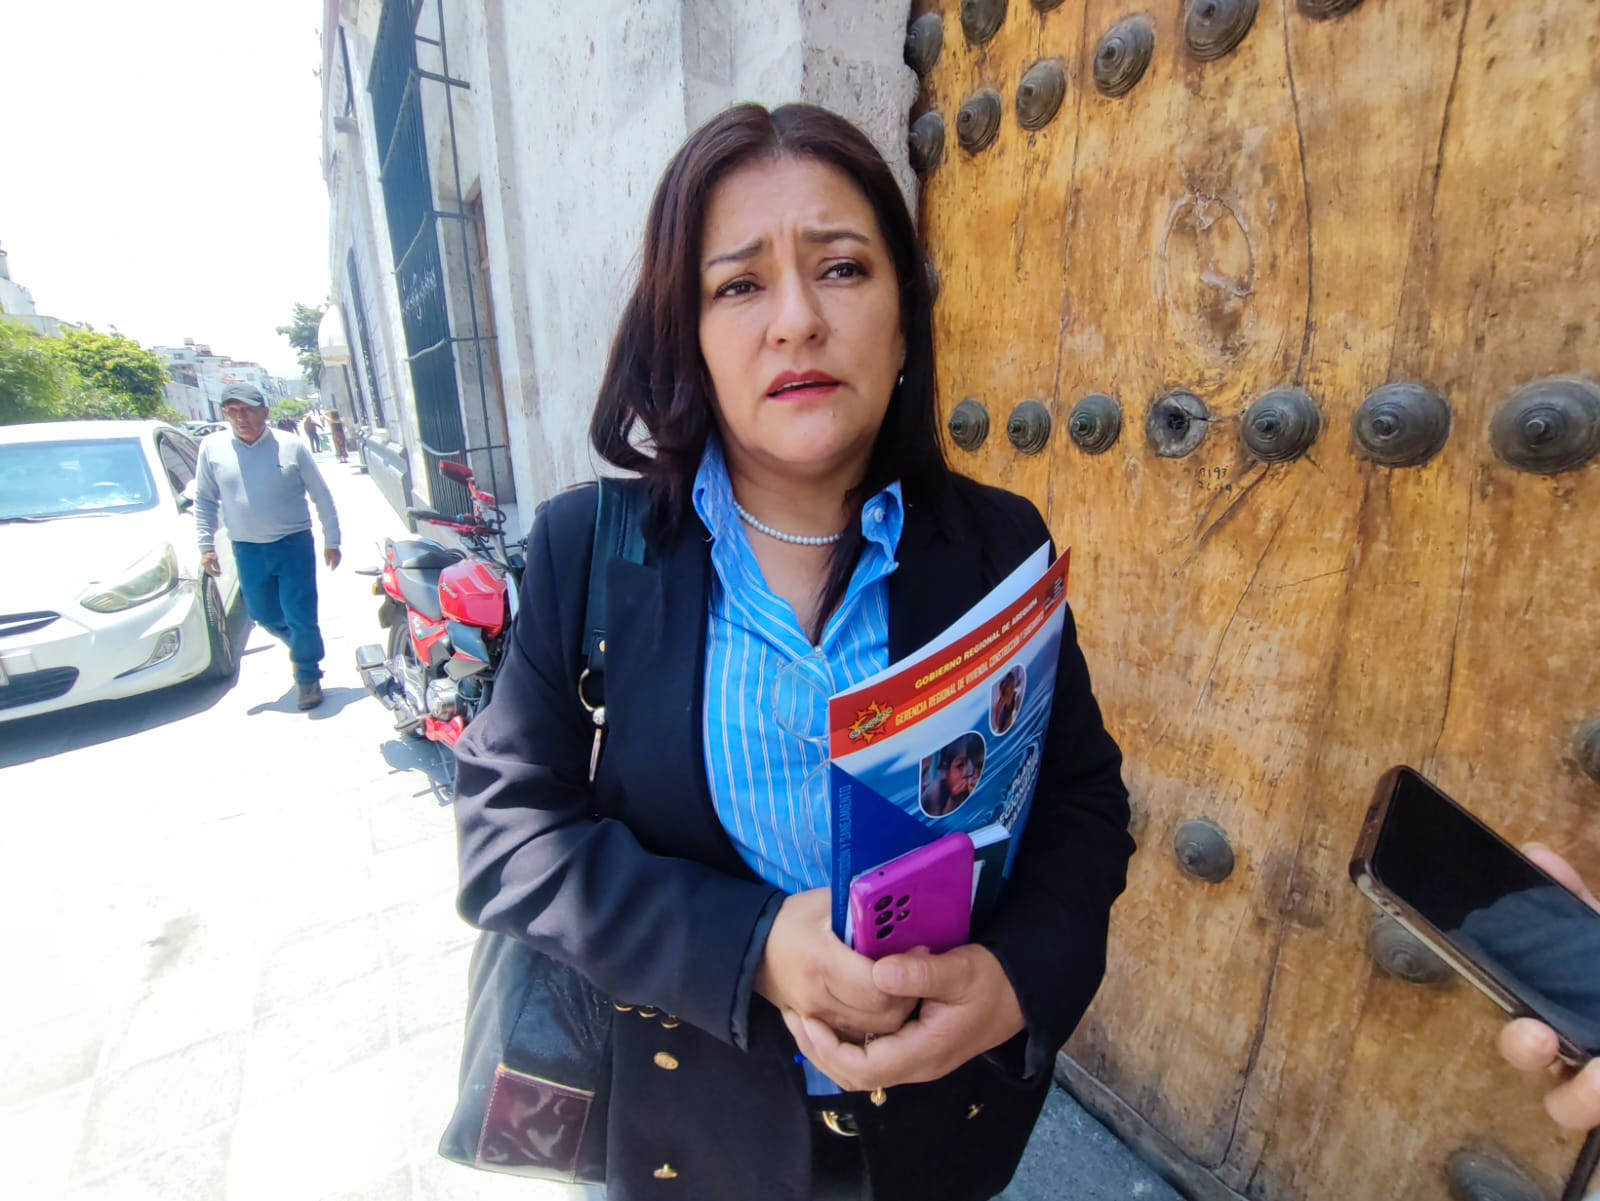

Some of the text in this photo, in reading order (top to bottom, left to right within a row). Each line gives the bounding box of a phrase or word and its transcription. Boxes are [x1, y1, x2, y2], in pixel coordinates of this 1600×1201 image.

[914, 655, 962, 689] GOBIERNO
[963, 629, 1001, 661] REGIONAL
[1001, 621, 1011, 634] DE
[895, 700, 928, 726] GERENCIA
[928, 682, 957, 708] REGIONAL
